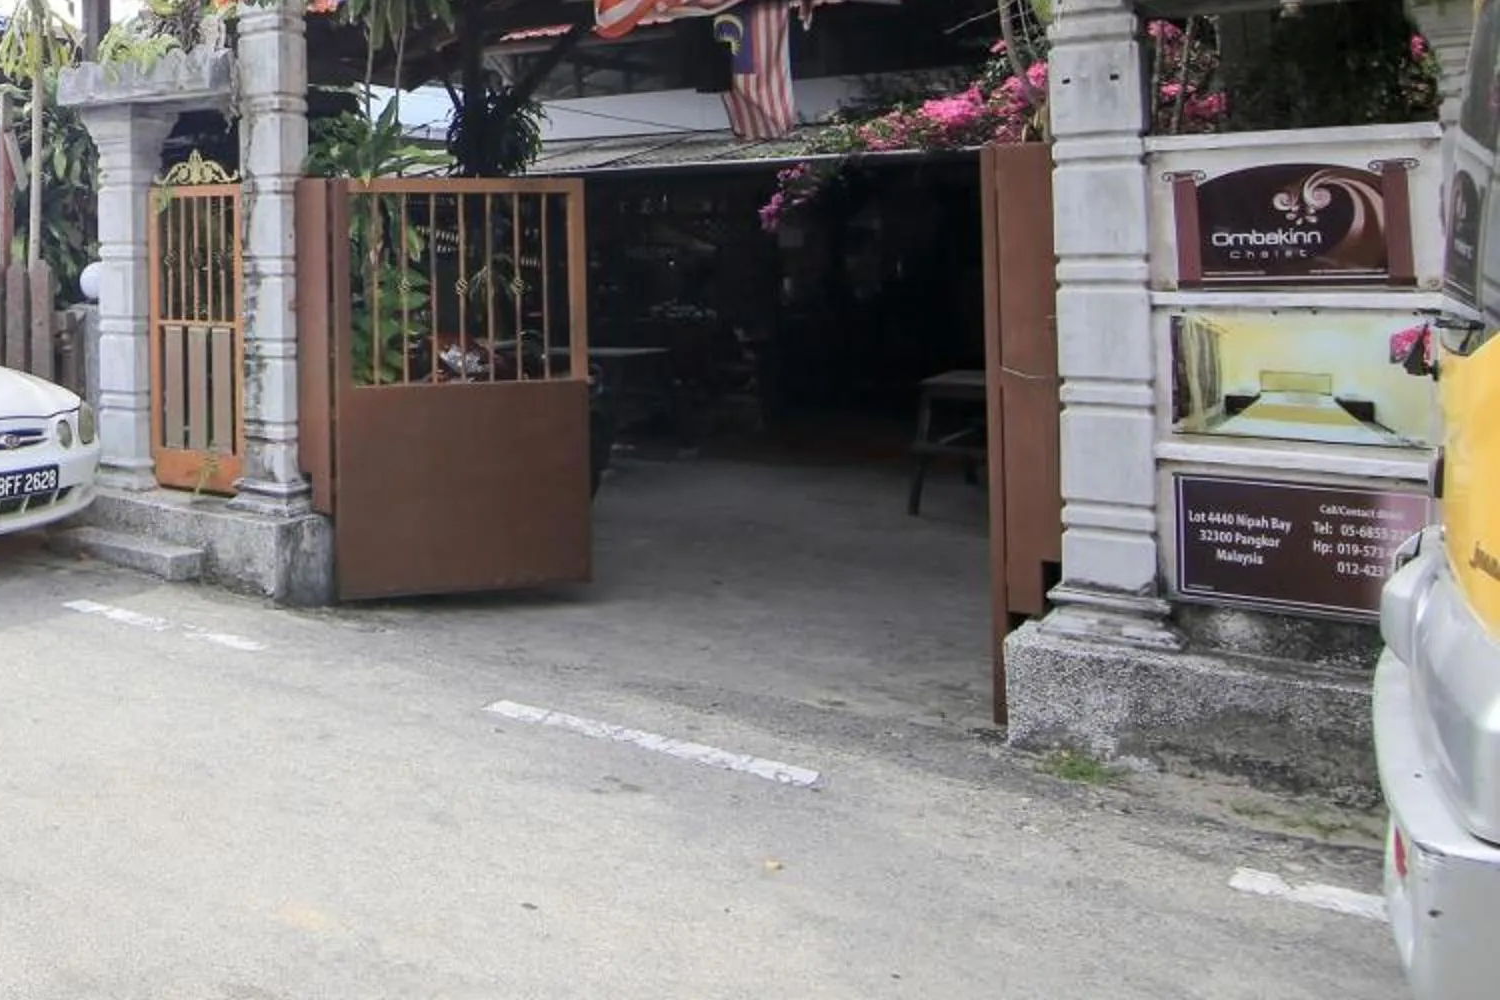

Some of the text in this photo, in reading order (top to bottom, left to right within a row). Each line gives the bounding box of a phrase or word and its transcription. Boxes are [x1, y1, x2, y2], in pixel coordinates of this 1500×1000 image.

[24, 469, 57, 492] 2628
[1188, 509, 1292, 535] Lot 4440 Nipah Bay
[1312, 521, 1333, 535] Tel:
[1199, 529, 1282, 549] 32300 Pangkor
[1313, 540, 1334, 556] Hp:
[1215, 548, 1264, 567] Malaysia
